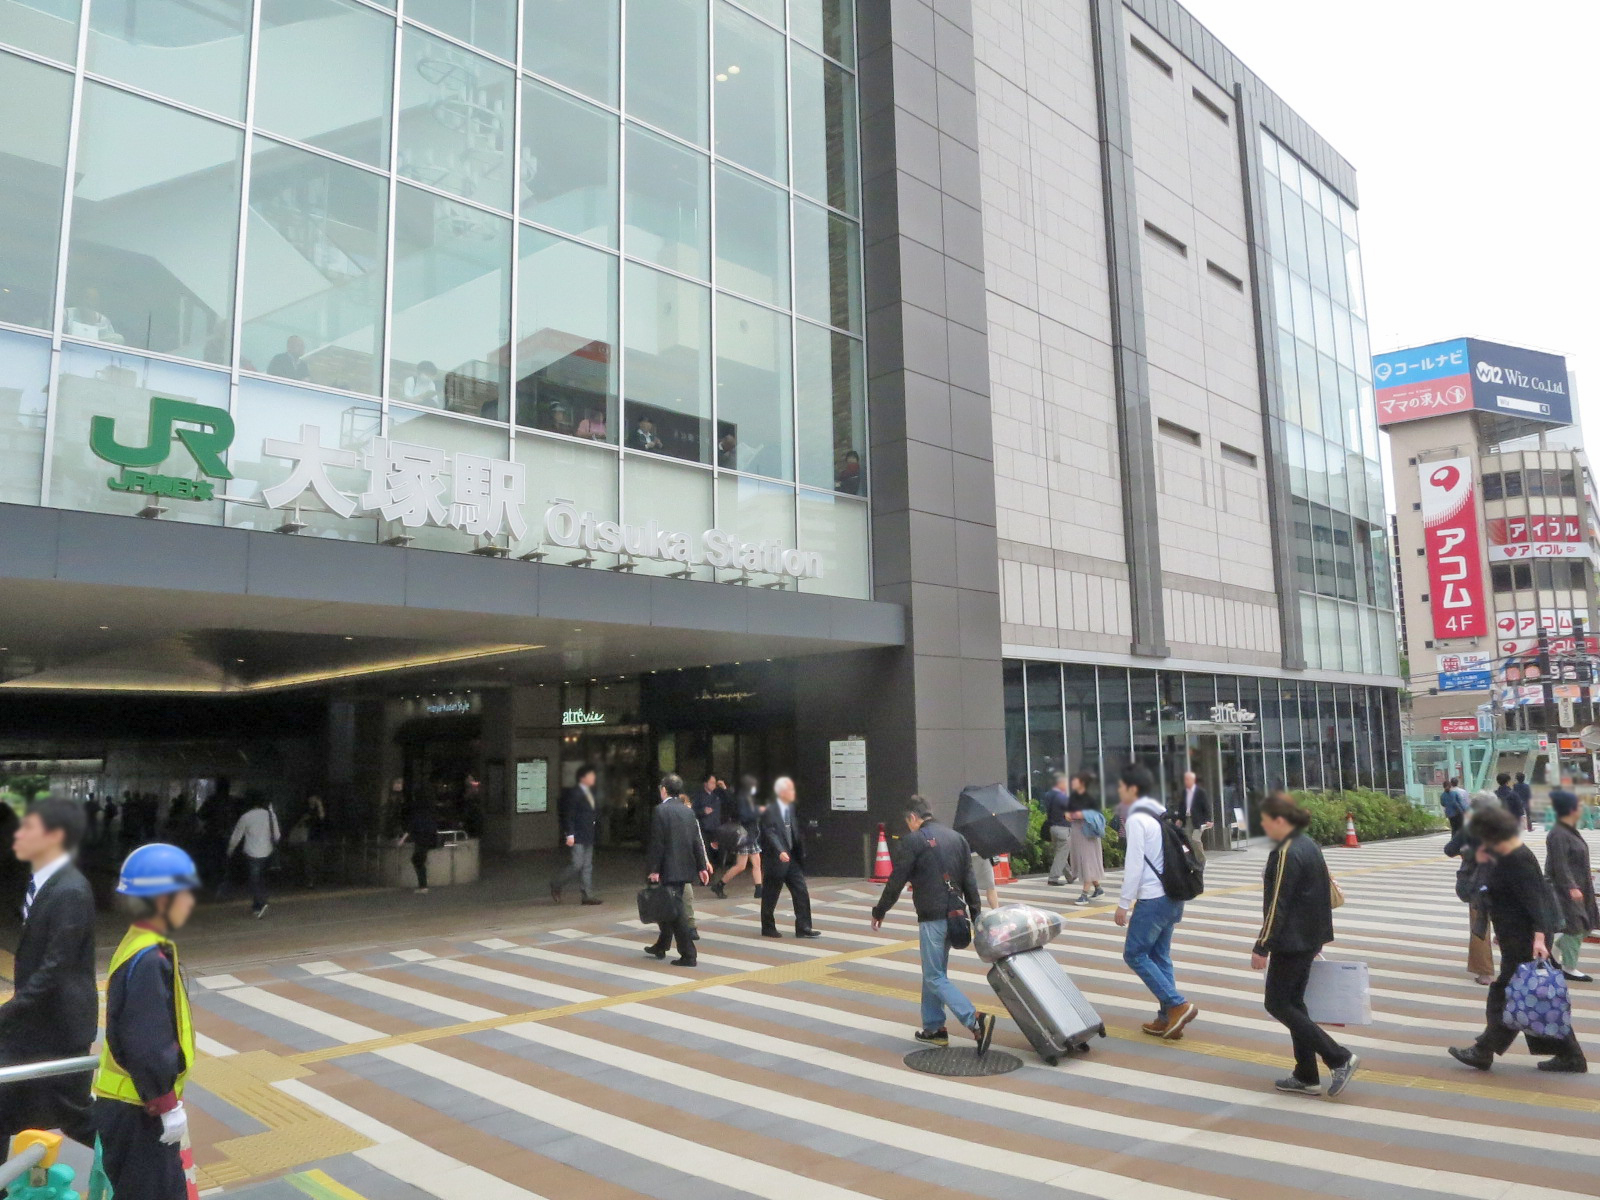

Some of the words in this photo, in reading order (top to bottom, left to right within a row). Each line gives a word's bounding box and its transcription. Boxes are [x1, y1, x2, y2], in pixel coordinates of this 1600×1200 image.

[1394, 350, 1463, 376] コールナビ
[1504, 368, 1529, 388] Wiz
[1379, 391, 1448, 414] ママの求人
[90, 396, 235, 480] JR
[107, 469, 215, 501] JR東日本
[262, 423, 527, 541] 大塚駅
[1509, 522, 1578, 538] アイフル
[702, 528, 824, 579] Station
[1518, 544, 1563, 556] アイフル
[1436, 527, 1472, 609] アコム
[1445, 614, 1474, 632] 4F
[1520, 616, 1572, 631] アコム
[1443, 657, 1459, 672] 歯
